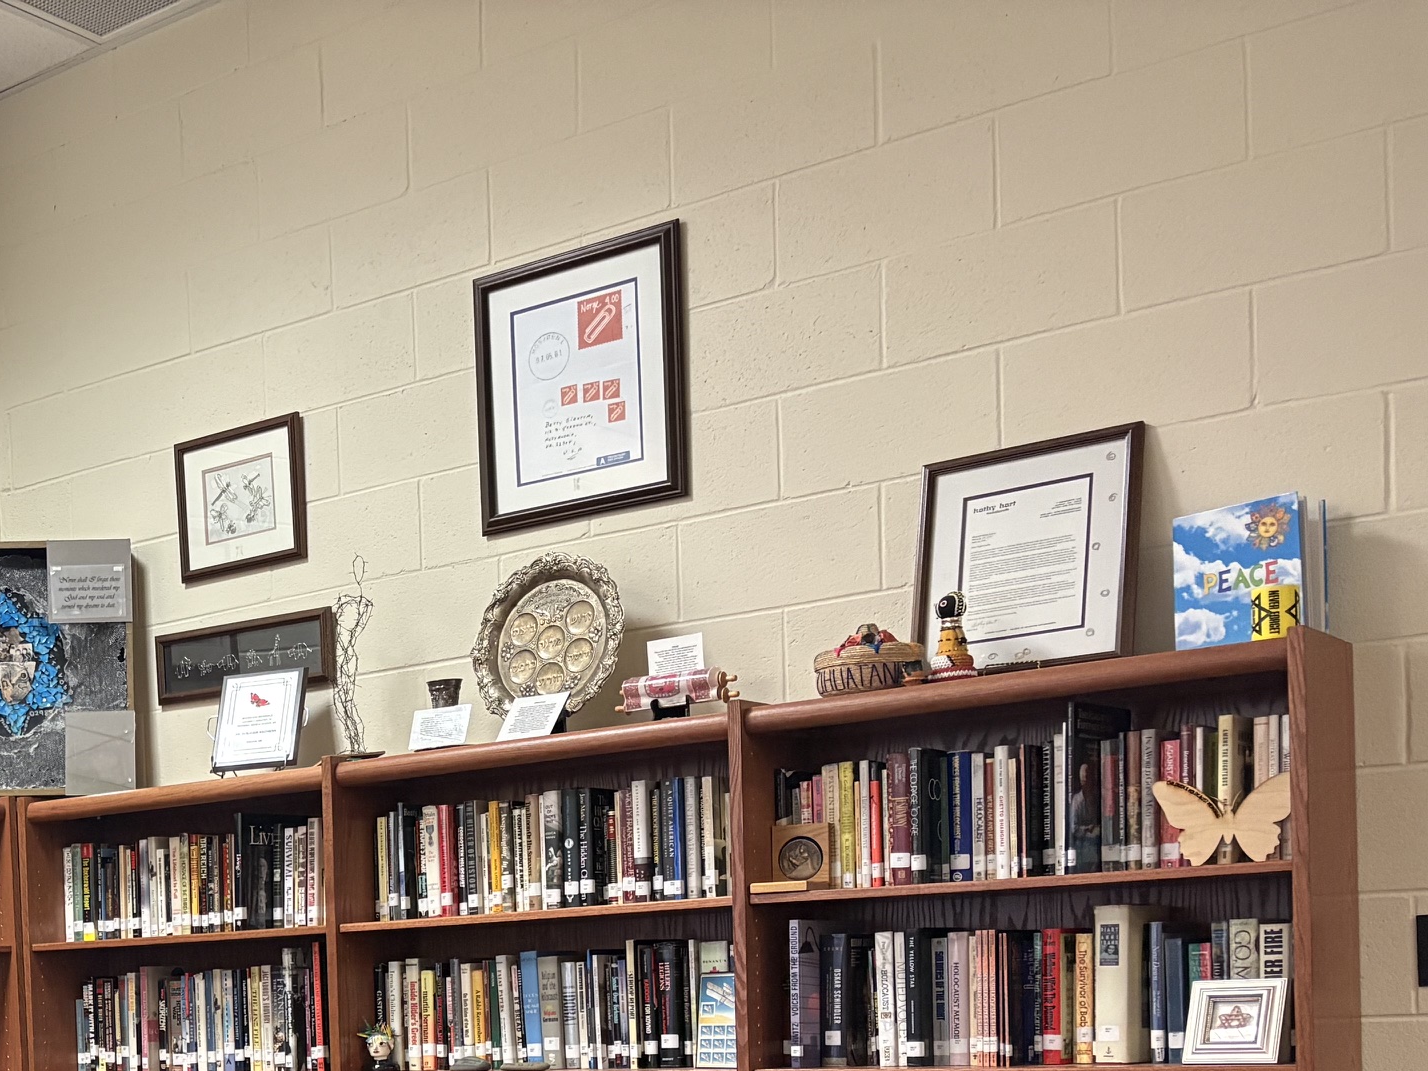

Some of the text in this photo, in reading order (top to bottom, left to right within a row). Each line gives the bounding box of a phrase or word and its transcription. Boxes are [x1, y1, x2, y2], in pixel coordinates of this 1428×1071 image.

[1203, 560, 1279, 596] PEACE
[1268, 590, 1280, 609] NEVER
[911, 817, 919, 837] CARE
[976, 797, 985, 844] HOLOCAUST
[580, 837, 589, 865] Hidden
[1264, 928, 1283, 957] FIRE
[791, 973, 799, 990] FROM
[1078, 965, 1088, 1000] Survivor
[410, 1000, 418, 1026] Hitler's
[791, 992, 799, 1017] VOICES
[834, 990, 842, 1024] SCHINDLER
